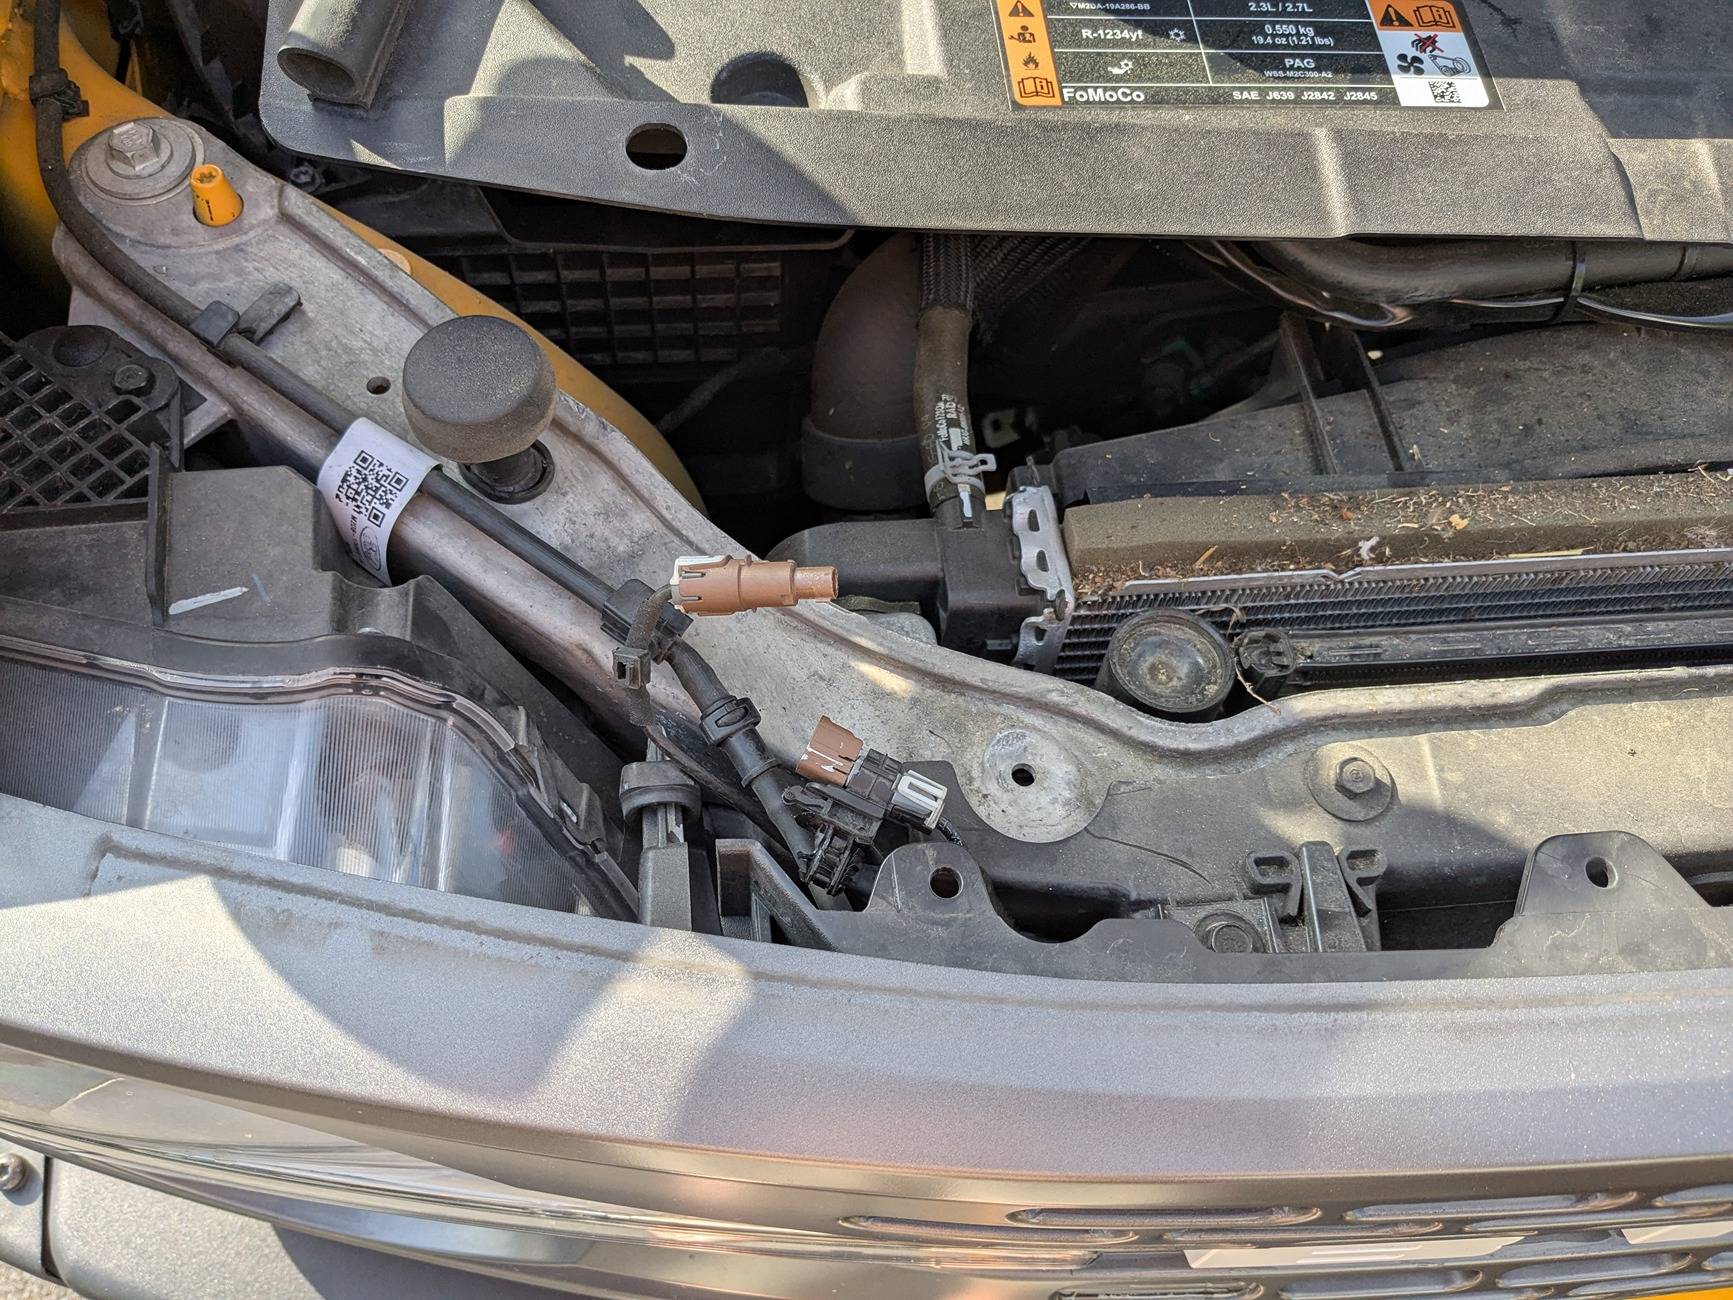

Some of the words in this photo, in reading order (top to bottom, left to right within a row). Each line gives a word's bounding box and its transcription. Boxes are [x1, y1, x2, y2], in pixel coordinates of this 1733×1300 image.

[1248, 2, 1276, 11] 2.3L
[1284, 2, 1314, 12] 2.7L
[1081, 29, 1143, 41] R-1234yf
[1264, 24, 1297, 35] 0.550
[1298, 25, 1315, 37] kg
[1251, 35, 1273, 45] 19.4
[1274, 37, 1288, 45] oz
[1288, 36, 1313, 46] (1.21
[1314, 36, 1334, 47] lbs)
[1284, 58, 1316, 69] PAG
[1062, 88, 1145, 102] FoMoCo
[1232, 91, 1260, 100] SAE
[1266, 91, 1295, 100] J639
[1301, 91, 1336, 100] J2842
[1343, 91, 1378, 101] J2845
